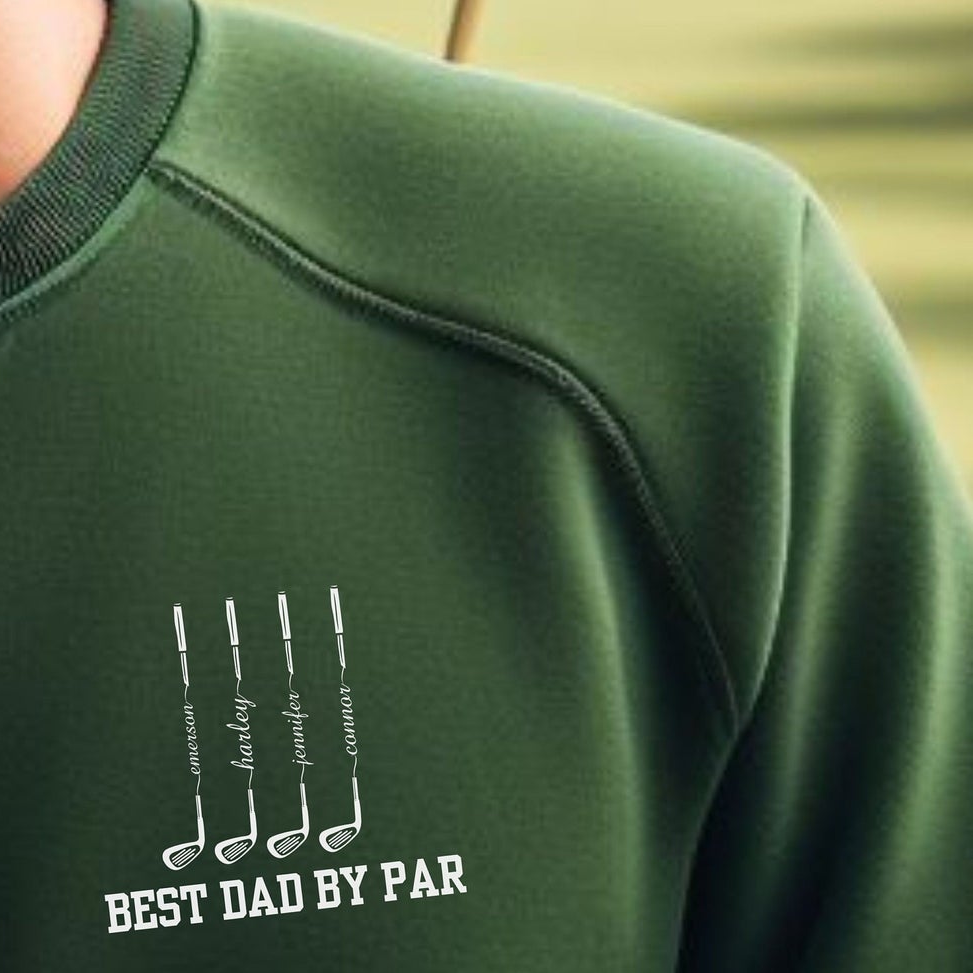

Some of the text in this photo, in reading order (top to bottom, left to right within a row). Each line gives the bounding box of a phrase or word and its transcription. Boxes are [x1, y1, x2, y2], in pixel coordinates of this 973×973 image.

[183, 701, 201, 775] emerson
[226, 694, 257, 770] harley
[281, 690, 314, 766] jennifer
[339, 683, 358, 756] connor
[104, 854, 468, 934] BEST DAD BY PAR
